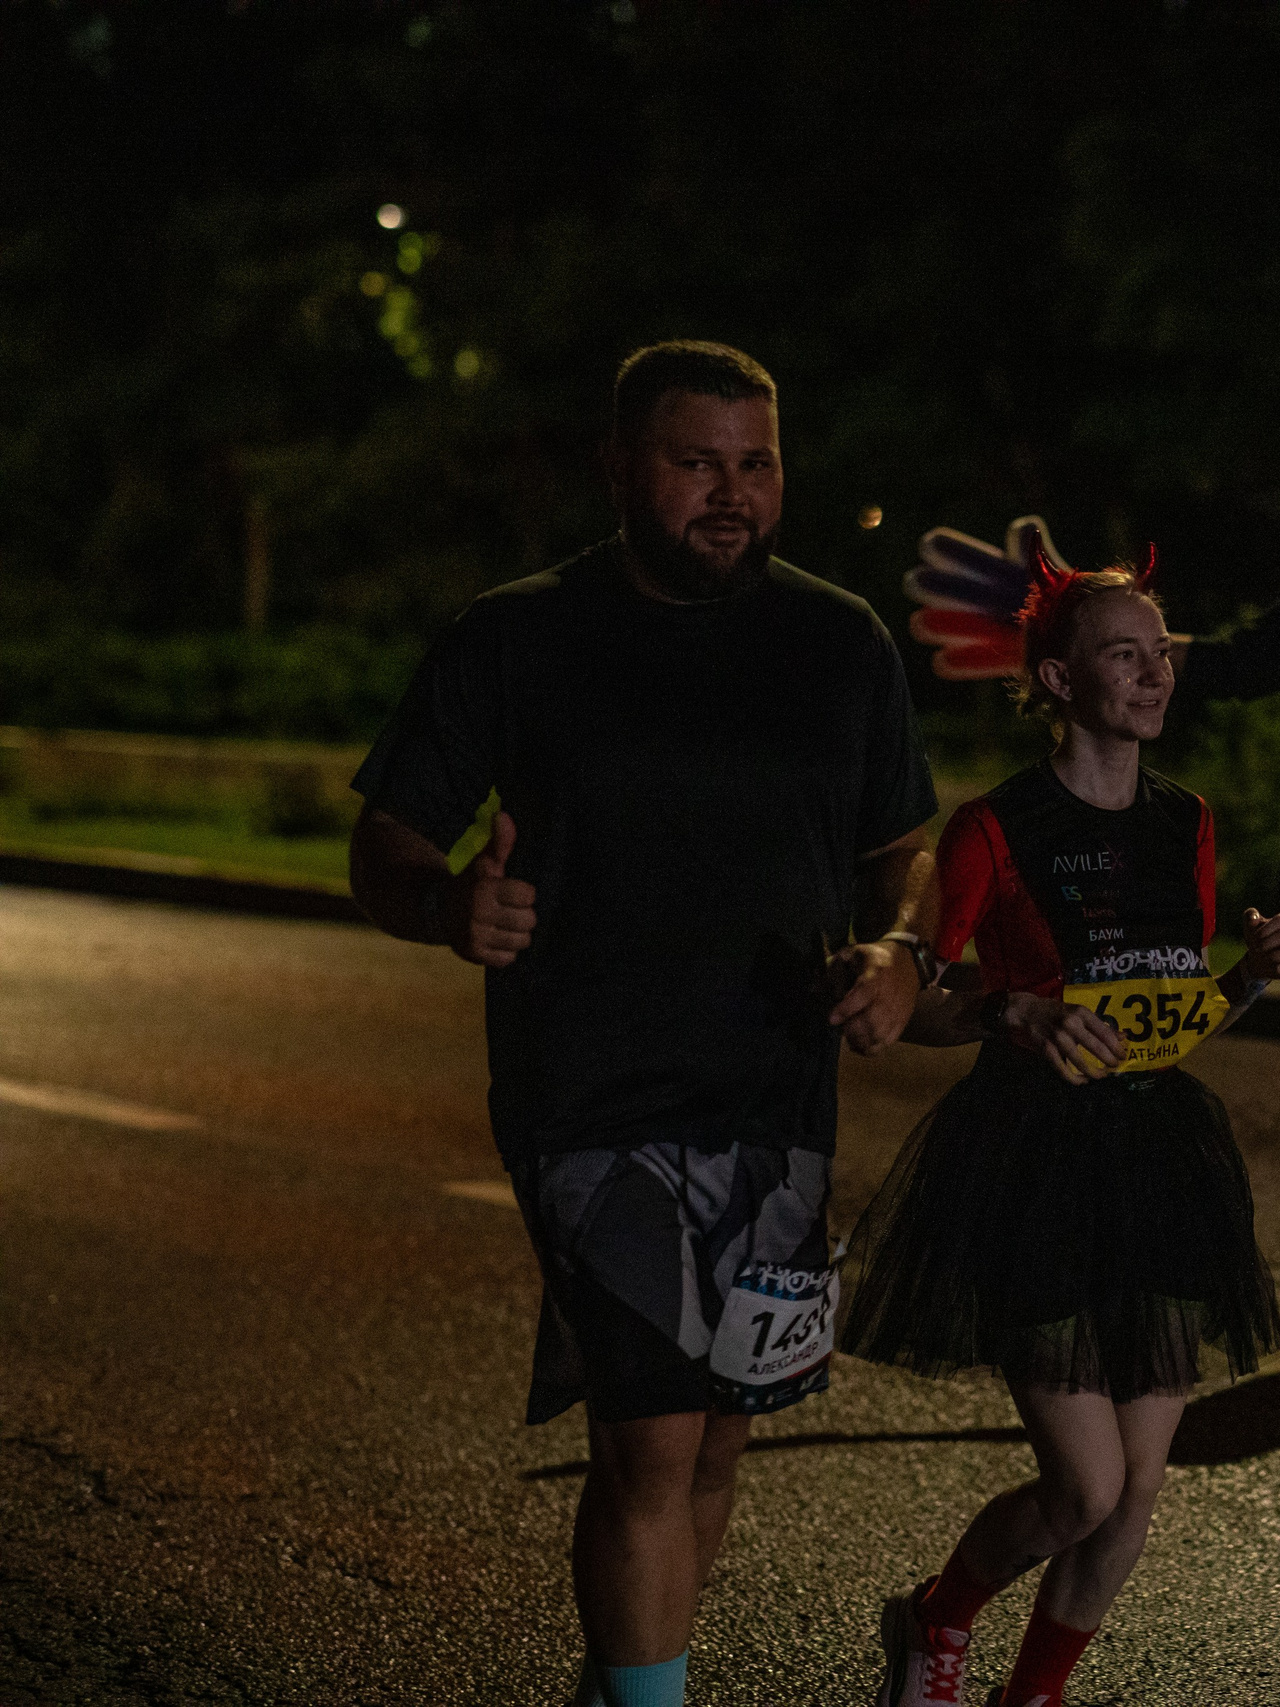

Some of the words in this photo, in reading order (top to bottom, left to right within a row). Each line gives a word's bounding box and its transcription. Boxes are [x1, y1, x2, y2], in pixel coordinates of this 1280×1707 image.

[1089, 928, 1124, 943] БАУМ
[1094, 991, 1210, 1042] 6354
[1124, 1043, 1180, 1061] АТЬЯНА
